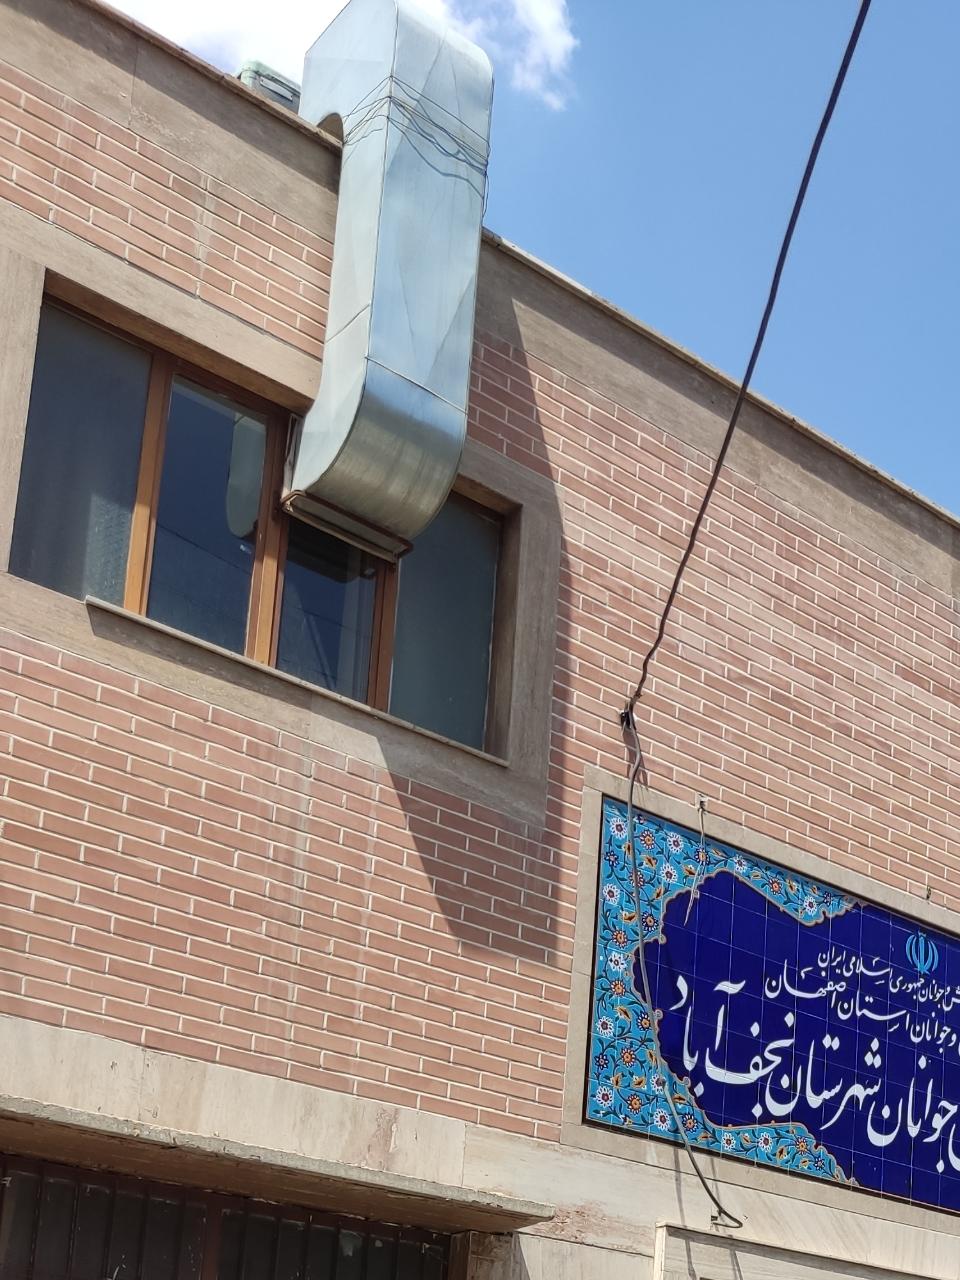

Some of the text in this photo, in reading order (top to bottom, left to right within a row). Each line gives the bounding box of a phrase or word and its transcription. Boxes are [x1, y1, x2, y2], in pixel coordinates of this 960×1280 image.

[817, 946, 847, 975] ایران
[843, 956, 894, 986] اسلامی
[763, 958, 848, 1010] اصفهان
[889, 975, 925, 1000] جمهوری
[917, 979, 944, 1009] جوانان
[837, 990, 911, 1033] استان
[909, 1012, 952, 1054] جوانان
[947, 1031, 957, 1048] و
[764, 1033, 882, 1131] شهرستان
[866, 1054, 959, 1174] جوانان
